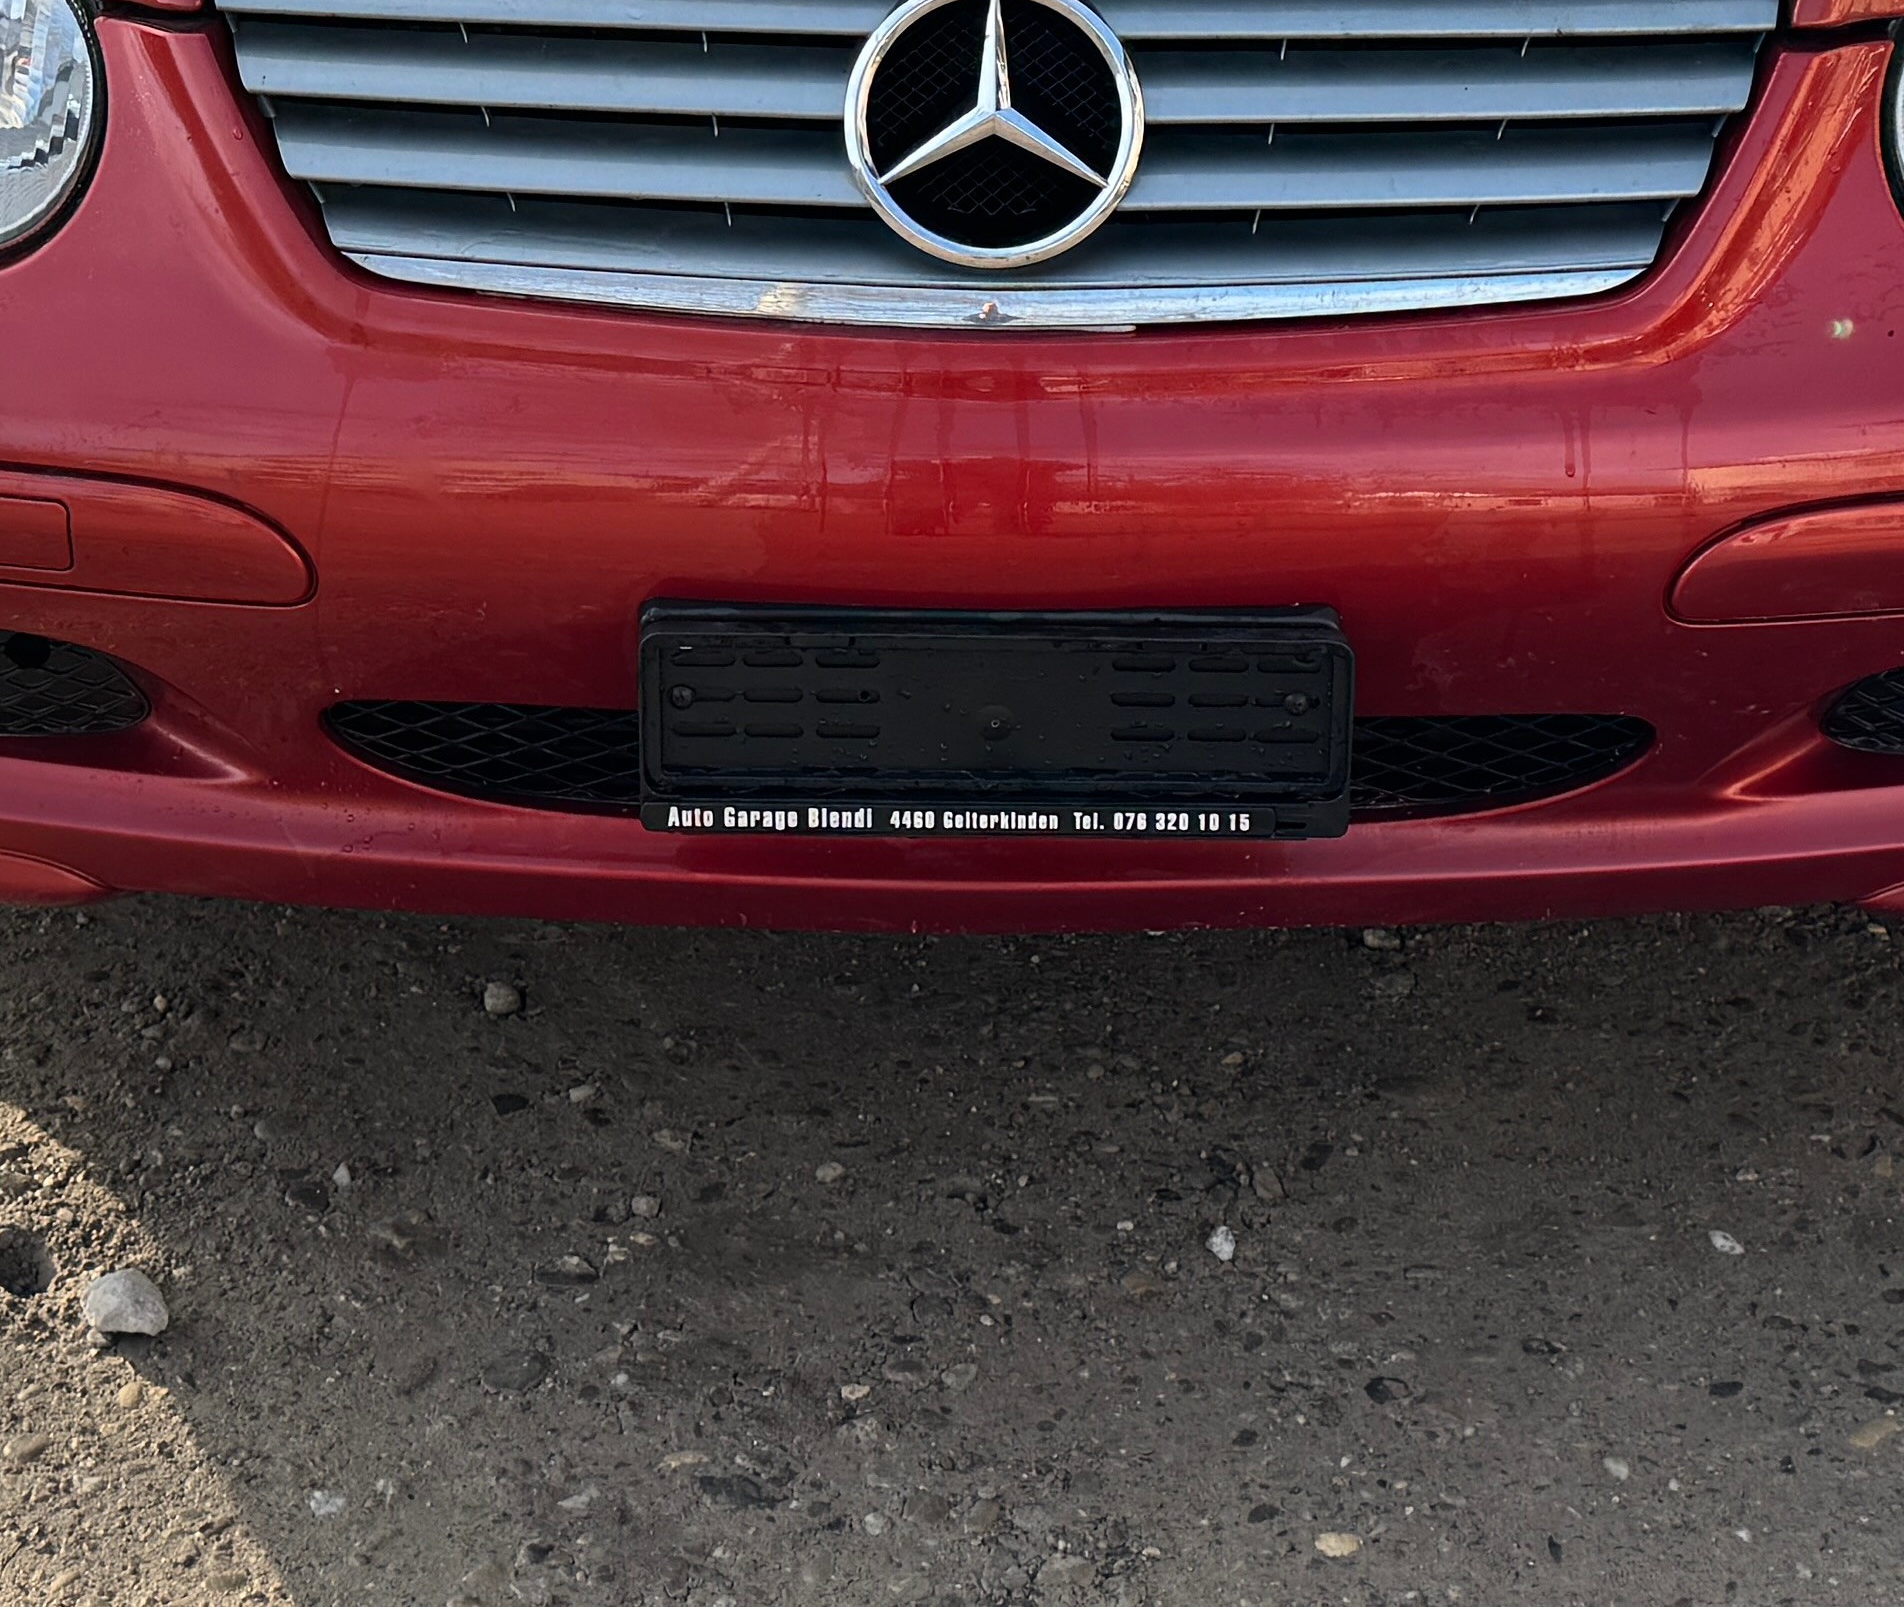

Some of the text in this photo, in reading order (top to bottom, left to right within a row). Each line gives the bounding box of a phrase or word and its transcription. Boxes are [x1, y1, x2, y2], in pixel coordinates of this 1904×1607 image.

[667, 806, 714, 828] Auto
[723, 806, 798, 831] Garage
[889, 810, 936, 830] 4460
[942, 810, 1059, 830] Gelterkinden
[1073, 811, 1105, 831] Tel.
[1113, 811, 1147, 831] 076
[1155, 812, 1189, 831] 320
[1198, 812, 1220, 832] 10
[1228, 813, 1251, 832] 15
